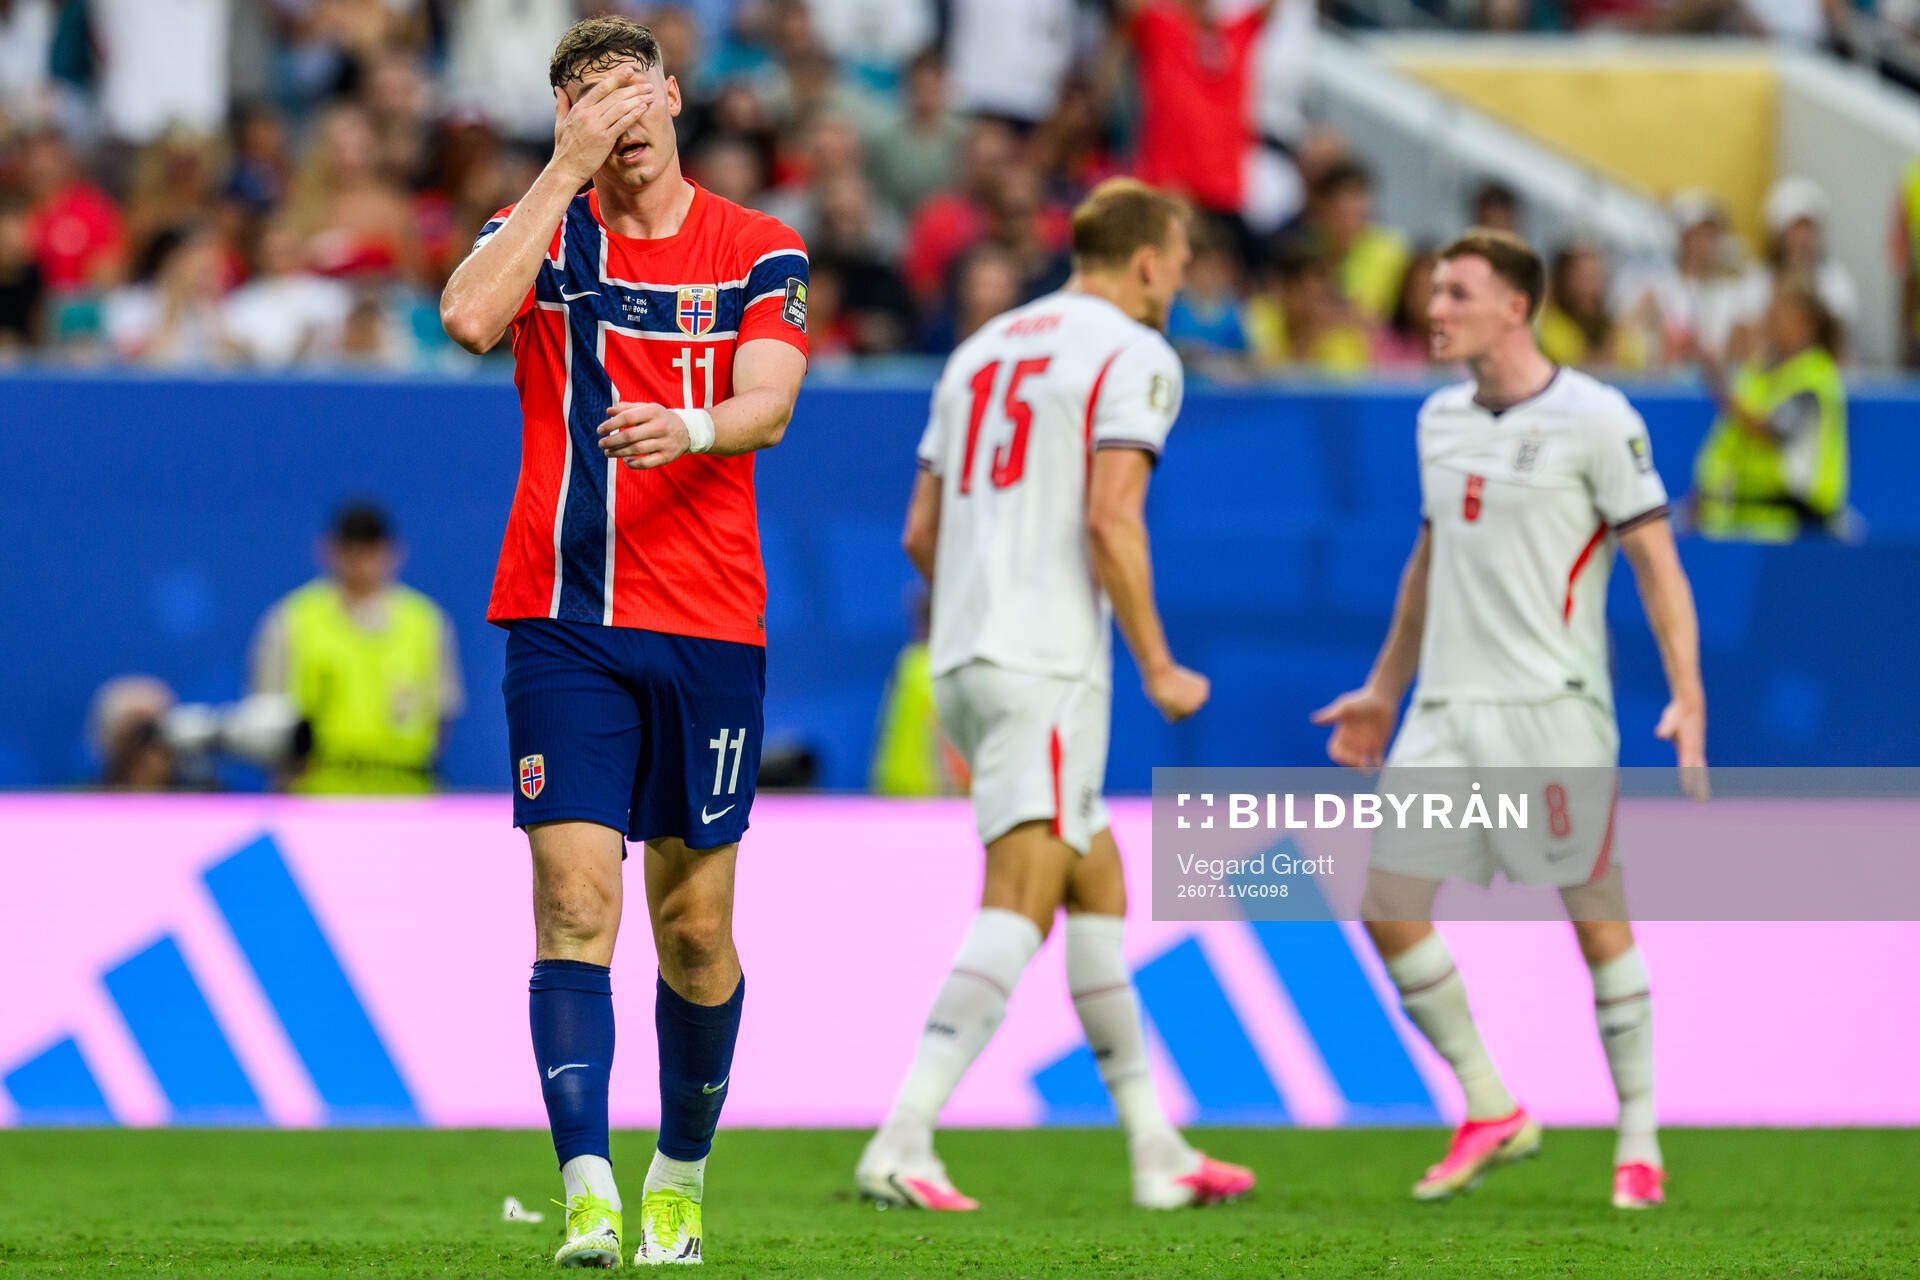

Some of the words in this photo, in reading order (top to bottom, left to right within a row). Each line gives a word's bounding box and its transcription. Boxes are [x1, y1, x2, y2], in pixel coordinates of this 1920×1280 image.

[672, 347, 715, 409] 11
[959, 355, 1051, 496] 15
[709, 728, 746, 795] 11
[1544, 783, 1572, 838] 8
